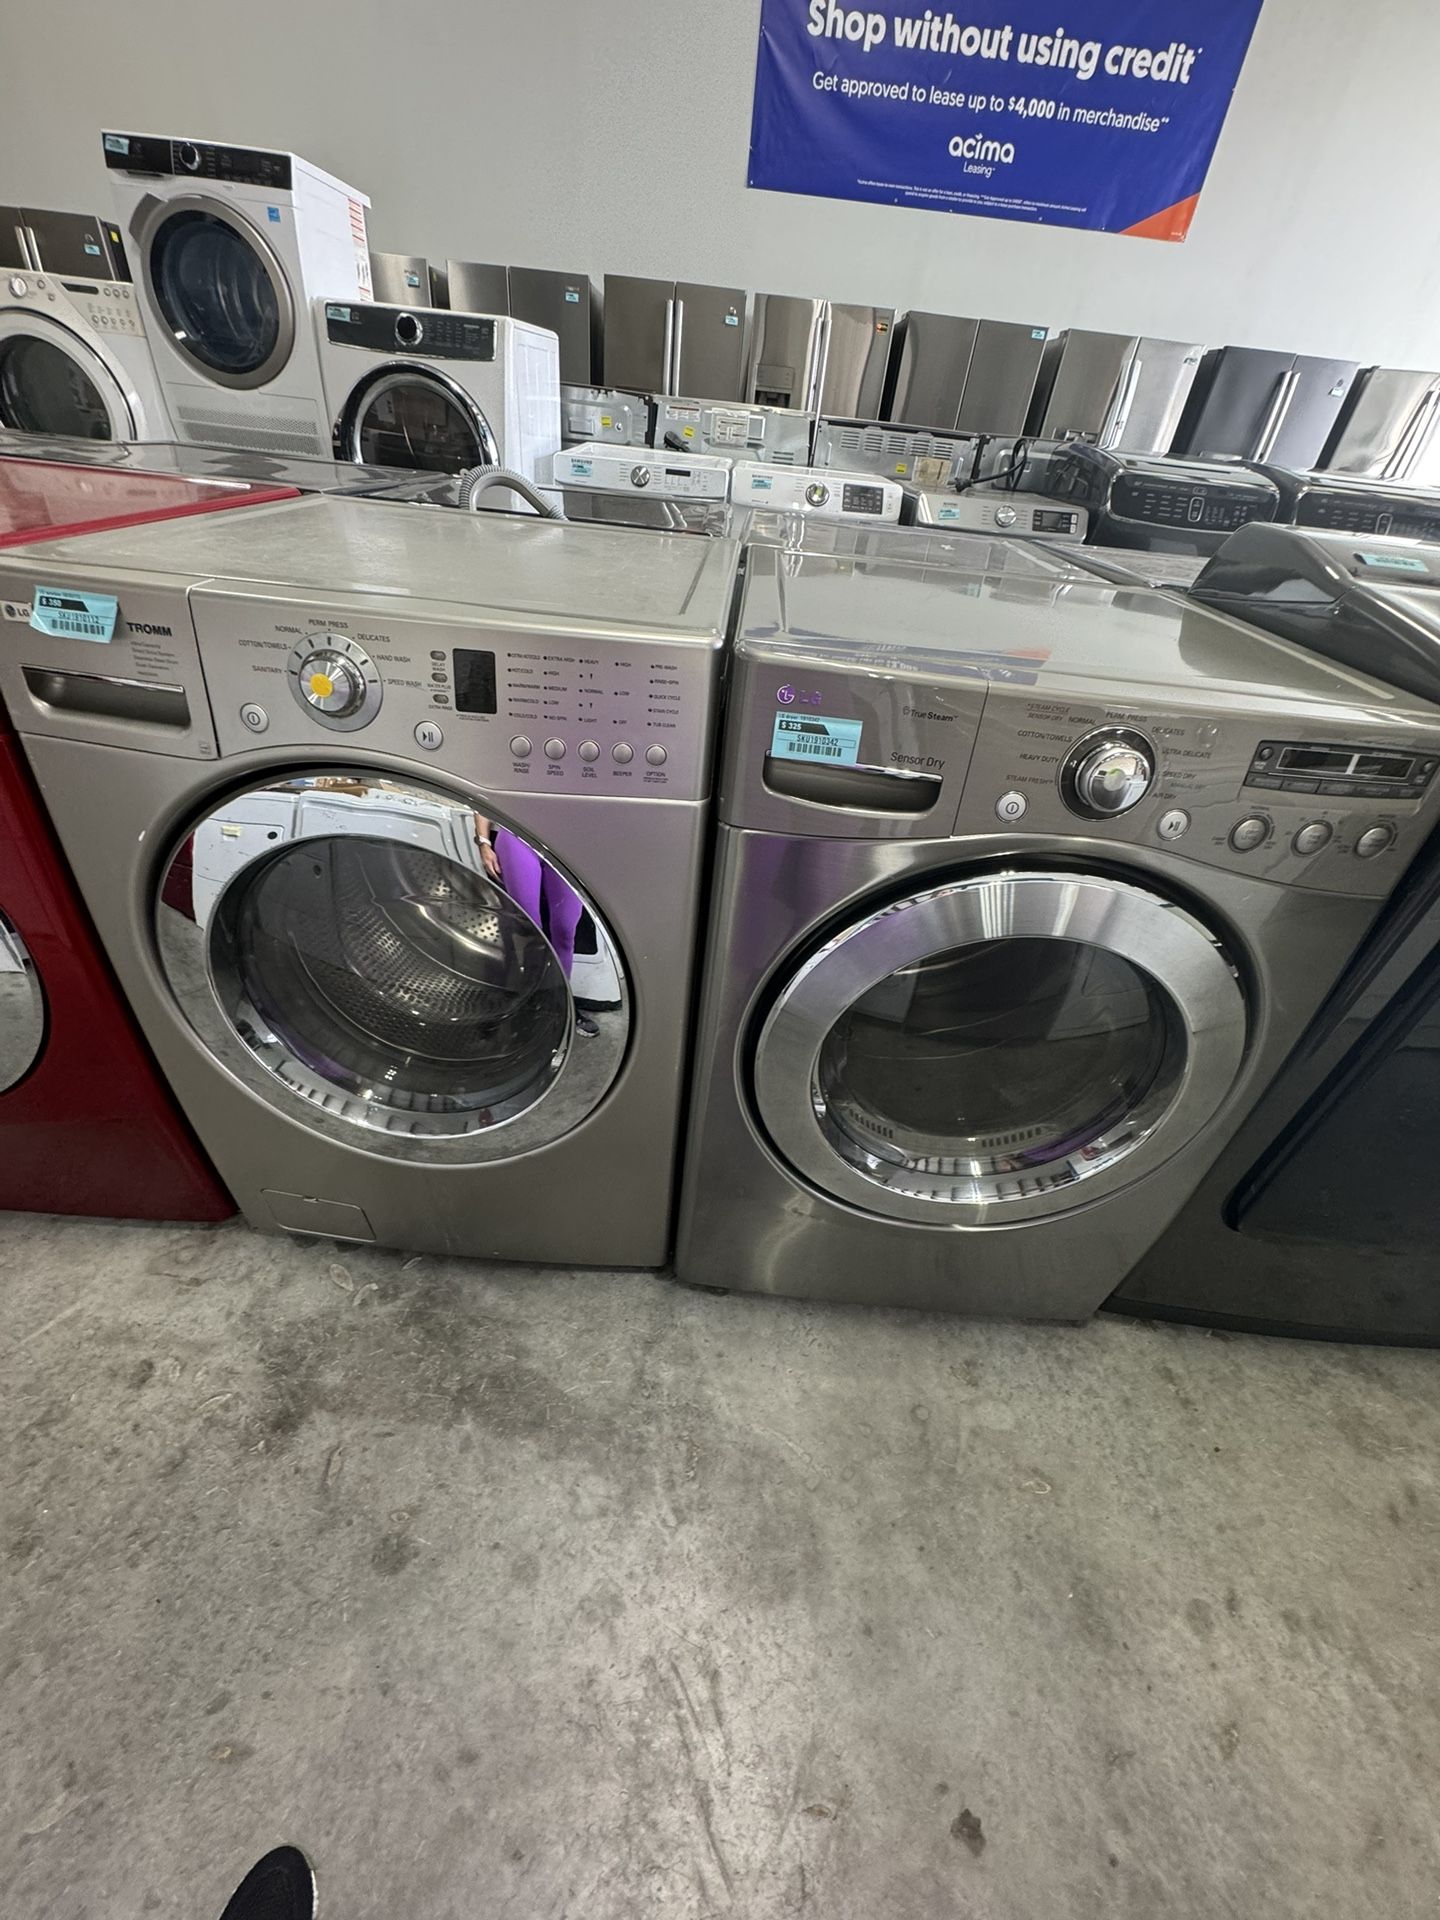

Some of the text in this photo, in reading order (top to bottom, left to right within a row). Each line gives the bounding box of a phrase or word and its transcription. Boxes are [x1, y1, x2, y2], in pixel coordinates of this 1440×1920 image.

[807, 0, 886, 52] Shop
[894, 10, 1013, 61] without
[1017, 27, 1102, 80] using
[813, 71, 838, 92] Get
[841, 77, 909, 99] approved
[912, 85, 926, 103] to
[929, 86, 964, 107] lease
[968, 94, 987, 113] up
[990, 95, 1004, 112] to
[1008, 96, 1055, 119] $4,000
[1057, 103, 1071, 121] in
[949, 133, 1014, 164] acima
[17, 608, 30, 617] LG
[328, 620, 348, 629] PRESS
[126, 622, 172, 637] TROMM
[275, 625, 302, 635] NORMAL
[357, 633, 391, 643] DELICATES
[252, 665, 282, 674] SANITARY
[800, 689, 821, 705] LG
[1068, 716, 1096, 725] NORMAL
[1128, 714, 1147, 722] PRESS
[781, 721, 787, 729] $
[1152, 727, 1185, 736] DELICATES
[797, 735, 839, 746] SKU1910342
[1162, 747, 1212, 759] ULTRA DELICATE
[891, 752, 945, 770] Sensor Dry
[1041, 755, 1059, 763] DUTY
[1006, 774, 1027, 782] STEAM
[1162, 770, 1182, 778] SPEED
